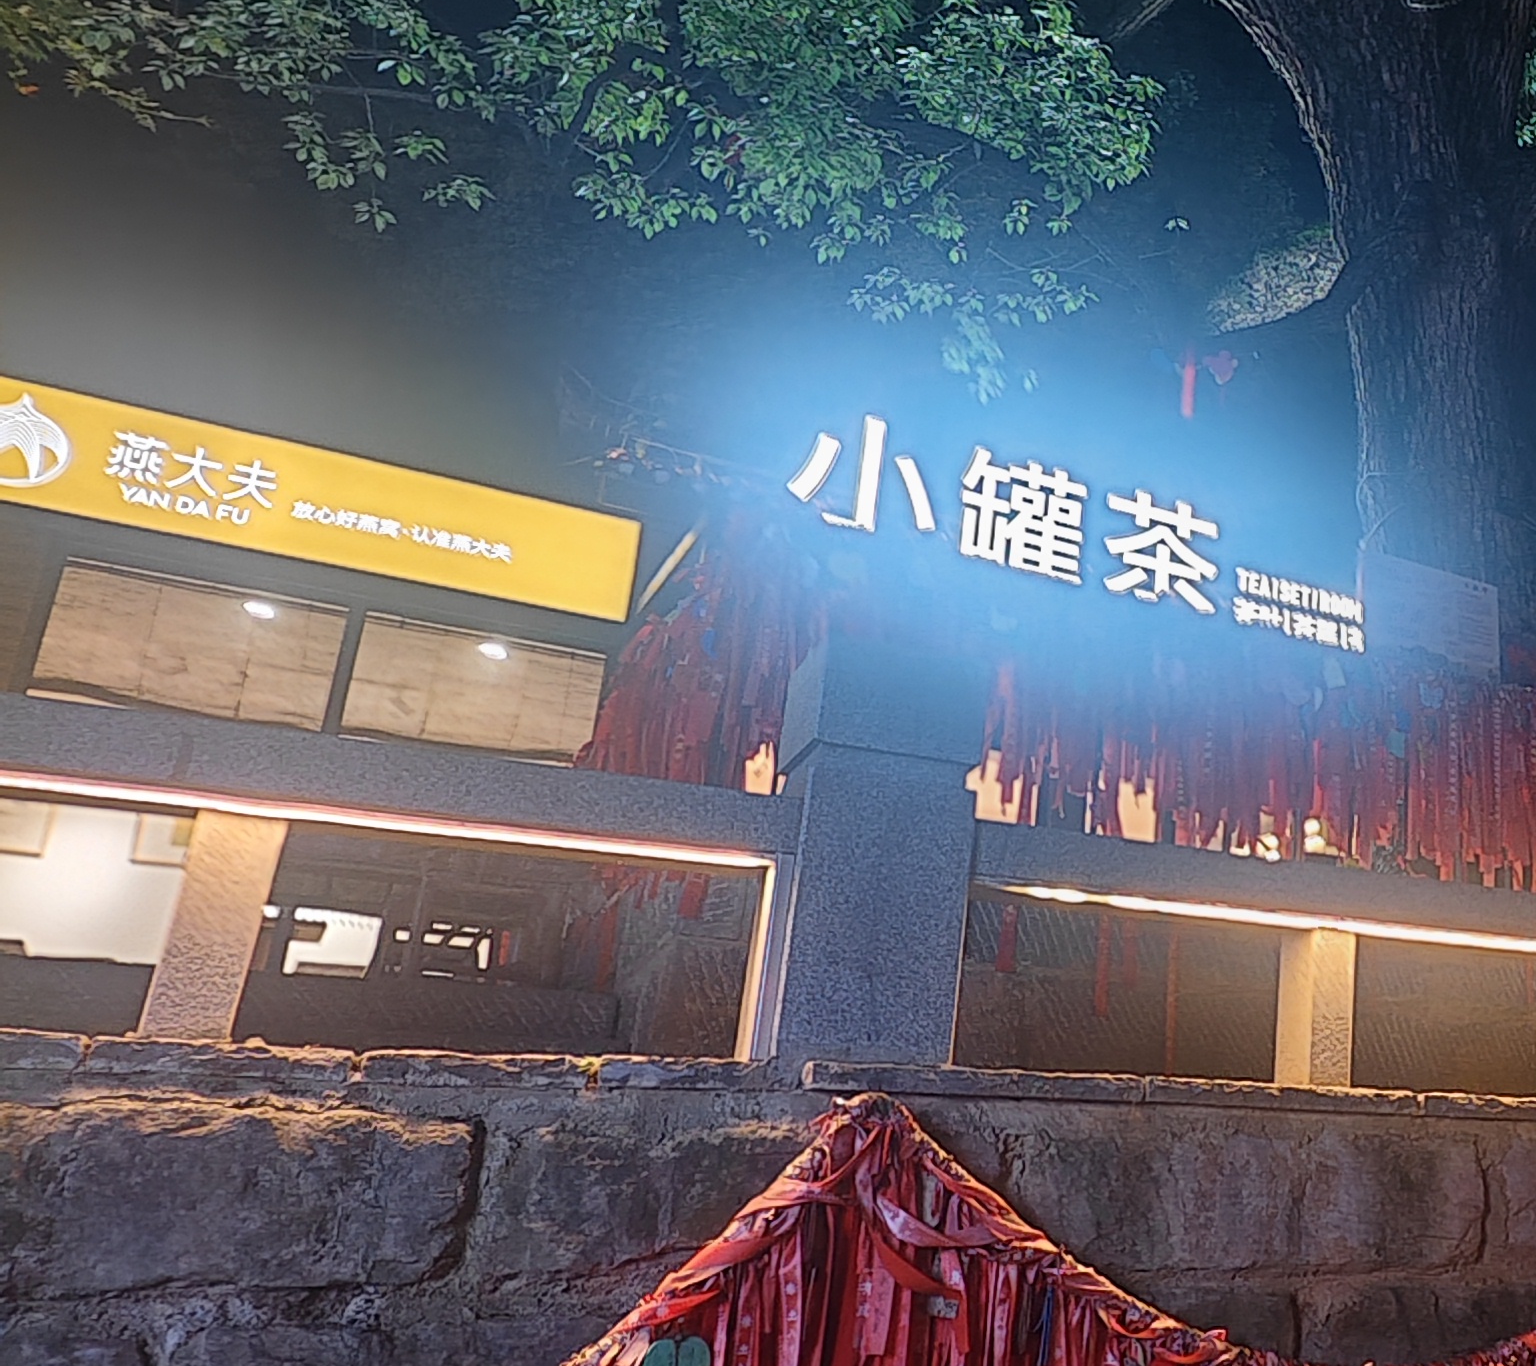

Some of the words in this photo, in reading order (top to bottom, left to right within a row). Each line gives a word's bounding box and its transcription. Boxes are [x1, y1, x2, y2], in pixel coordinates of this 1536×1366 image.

[103, 430, 278, 509] 燕大夫
[119, 481, 172, 511] YAN
[175, 495, 213, 521] DA
[215, 503, 250, 526] FU
[786, 412, 1219, 614] 小罐茶
